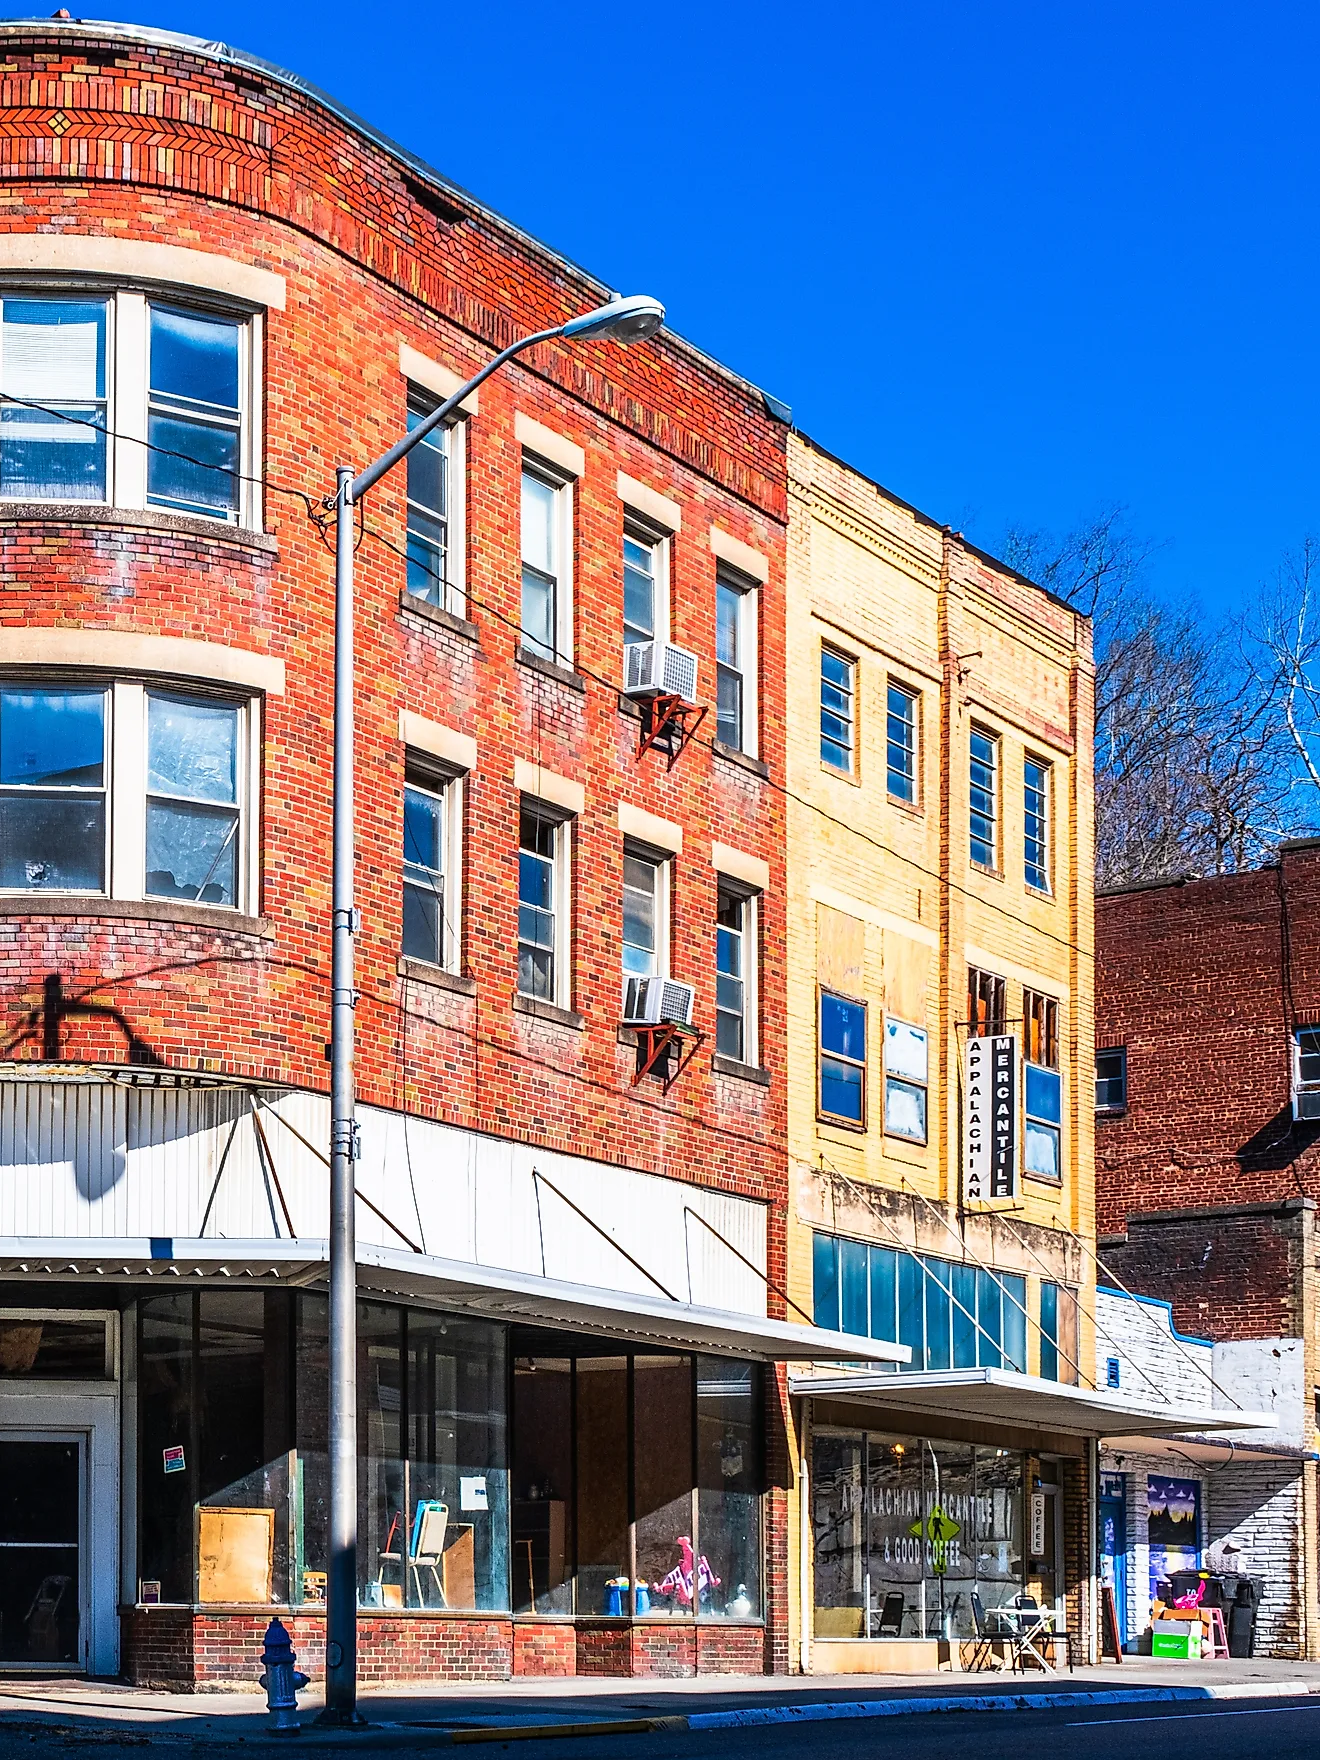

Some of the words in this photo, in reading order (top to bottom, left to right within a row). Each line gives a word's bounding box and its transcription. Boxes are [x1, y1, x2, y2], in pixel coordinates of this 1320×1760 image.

[968, 1041, 982, 1198] APPALACHIAN
[996, 1038, 1011, 1197] MERCANTILE
[883, 1536, 890, 1564] &
[894, 1537, 920, 1565] GOOD
[926, 1539, 961, 1567] COFFEE
